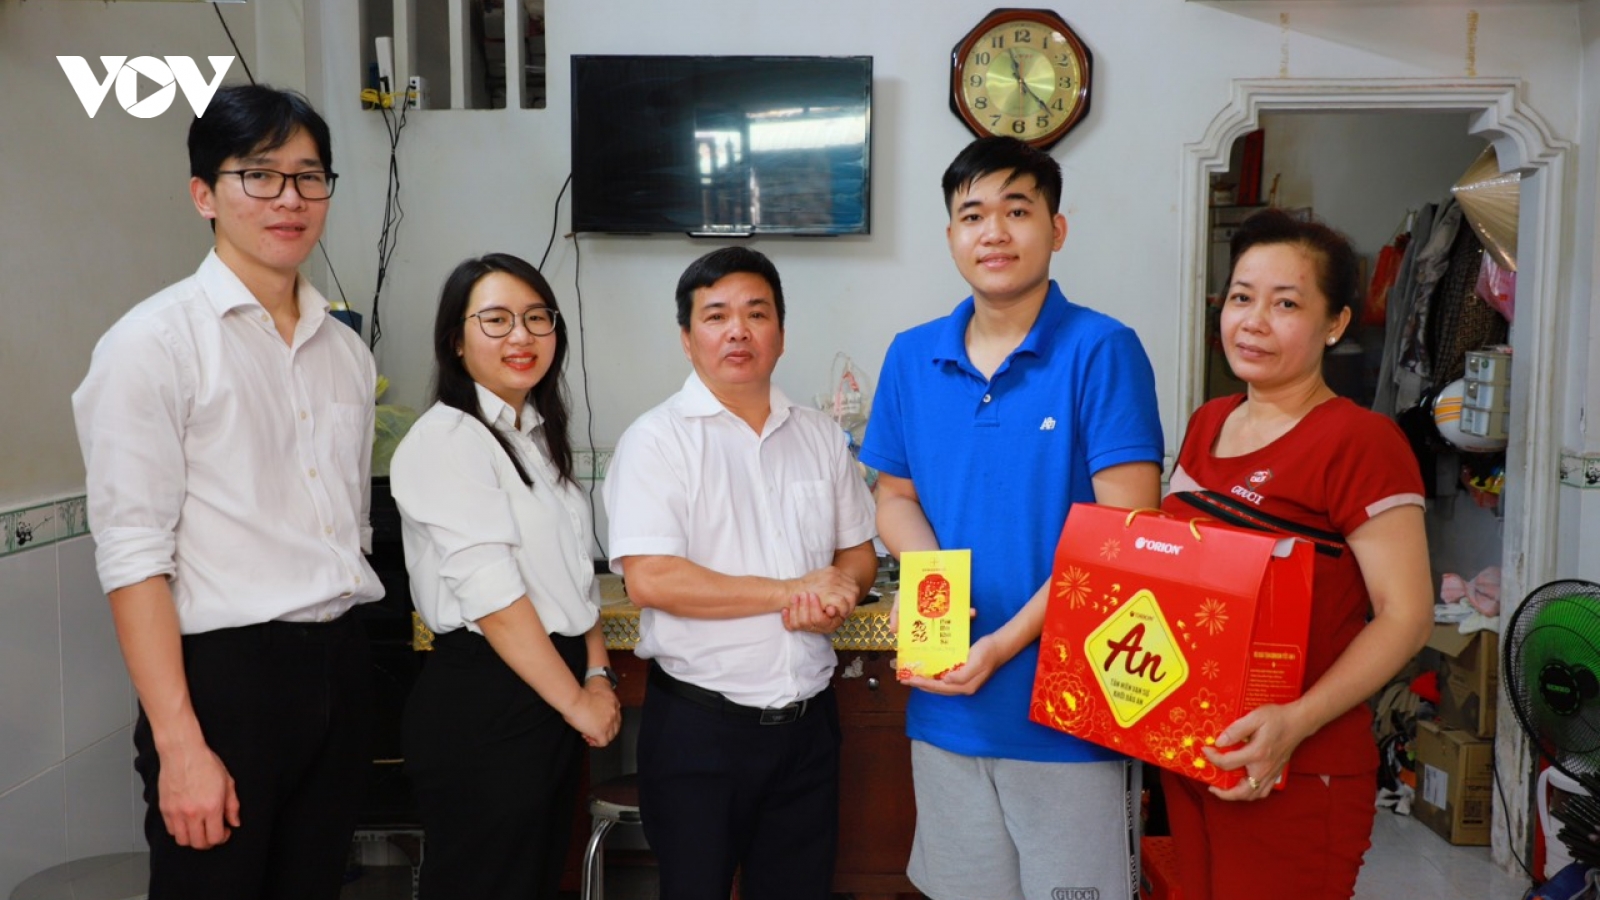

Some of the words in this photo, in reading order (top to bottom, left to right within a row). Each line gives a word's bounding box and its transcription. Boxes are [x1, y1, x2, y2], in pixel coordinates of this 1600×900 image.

[991, 36, 1005, 49] 11
[1014, 29, 1031, 43] 12
[1042, 36, 1049, 49] 1
[975, 52, 990, 66] 10
[1054, 53, 1069, 67] 2
[970, 74, 983, 88] 9
[1059, 76, 1071, 89] 3
[974, 97, 988, 109] 8
[1051, 98, 1064, 111] 4
[990, 115, 1002, 126] 7
[1036, 115, 1049, 128] 5
[1012, 121, 1026, 134] 6
[1103, 622, 1167, 683] An
